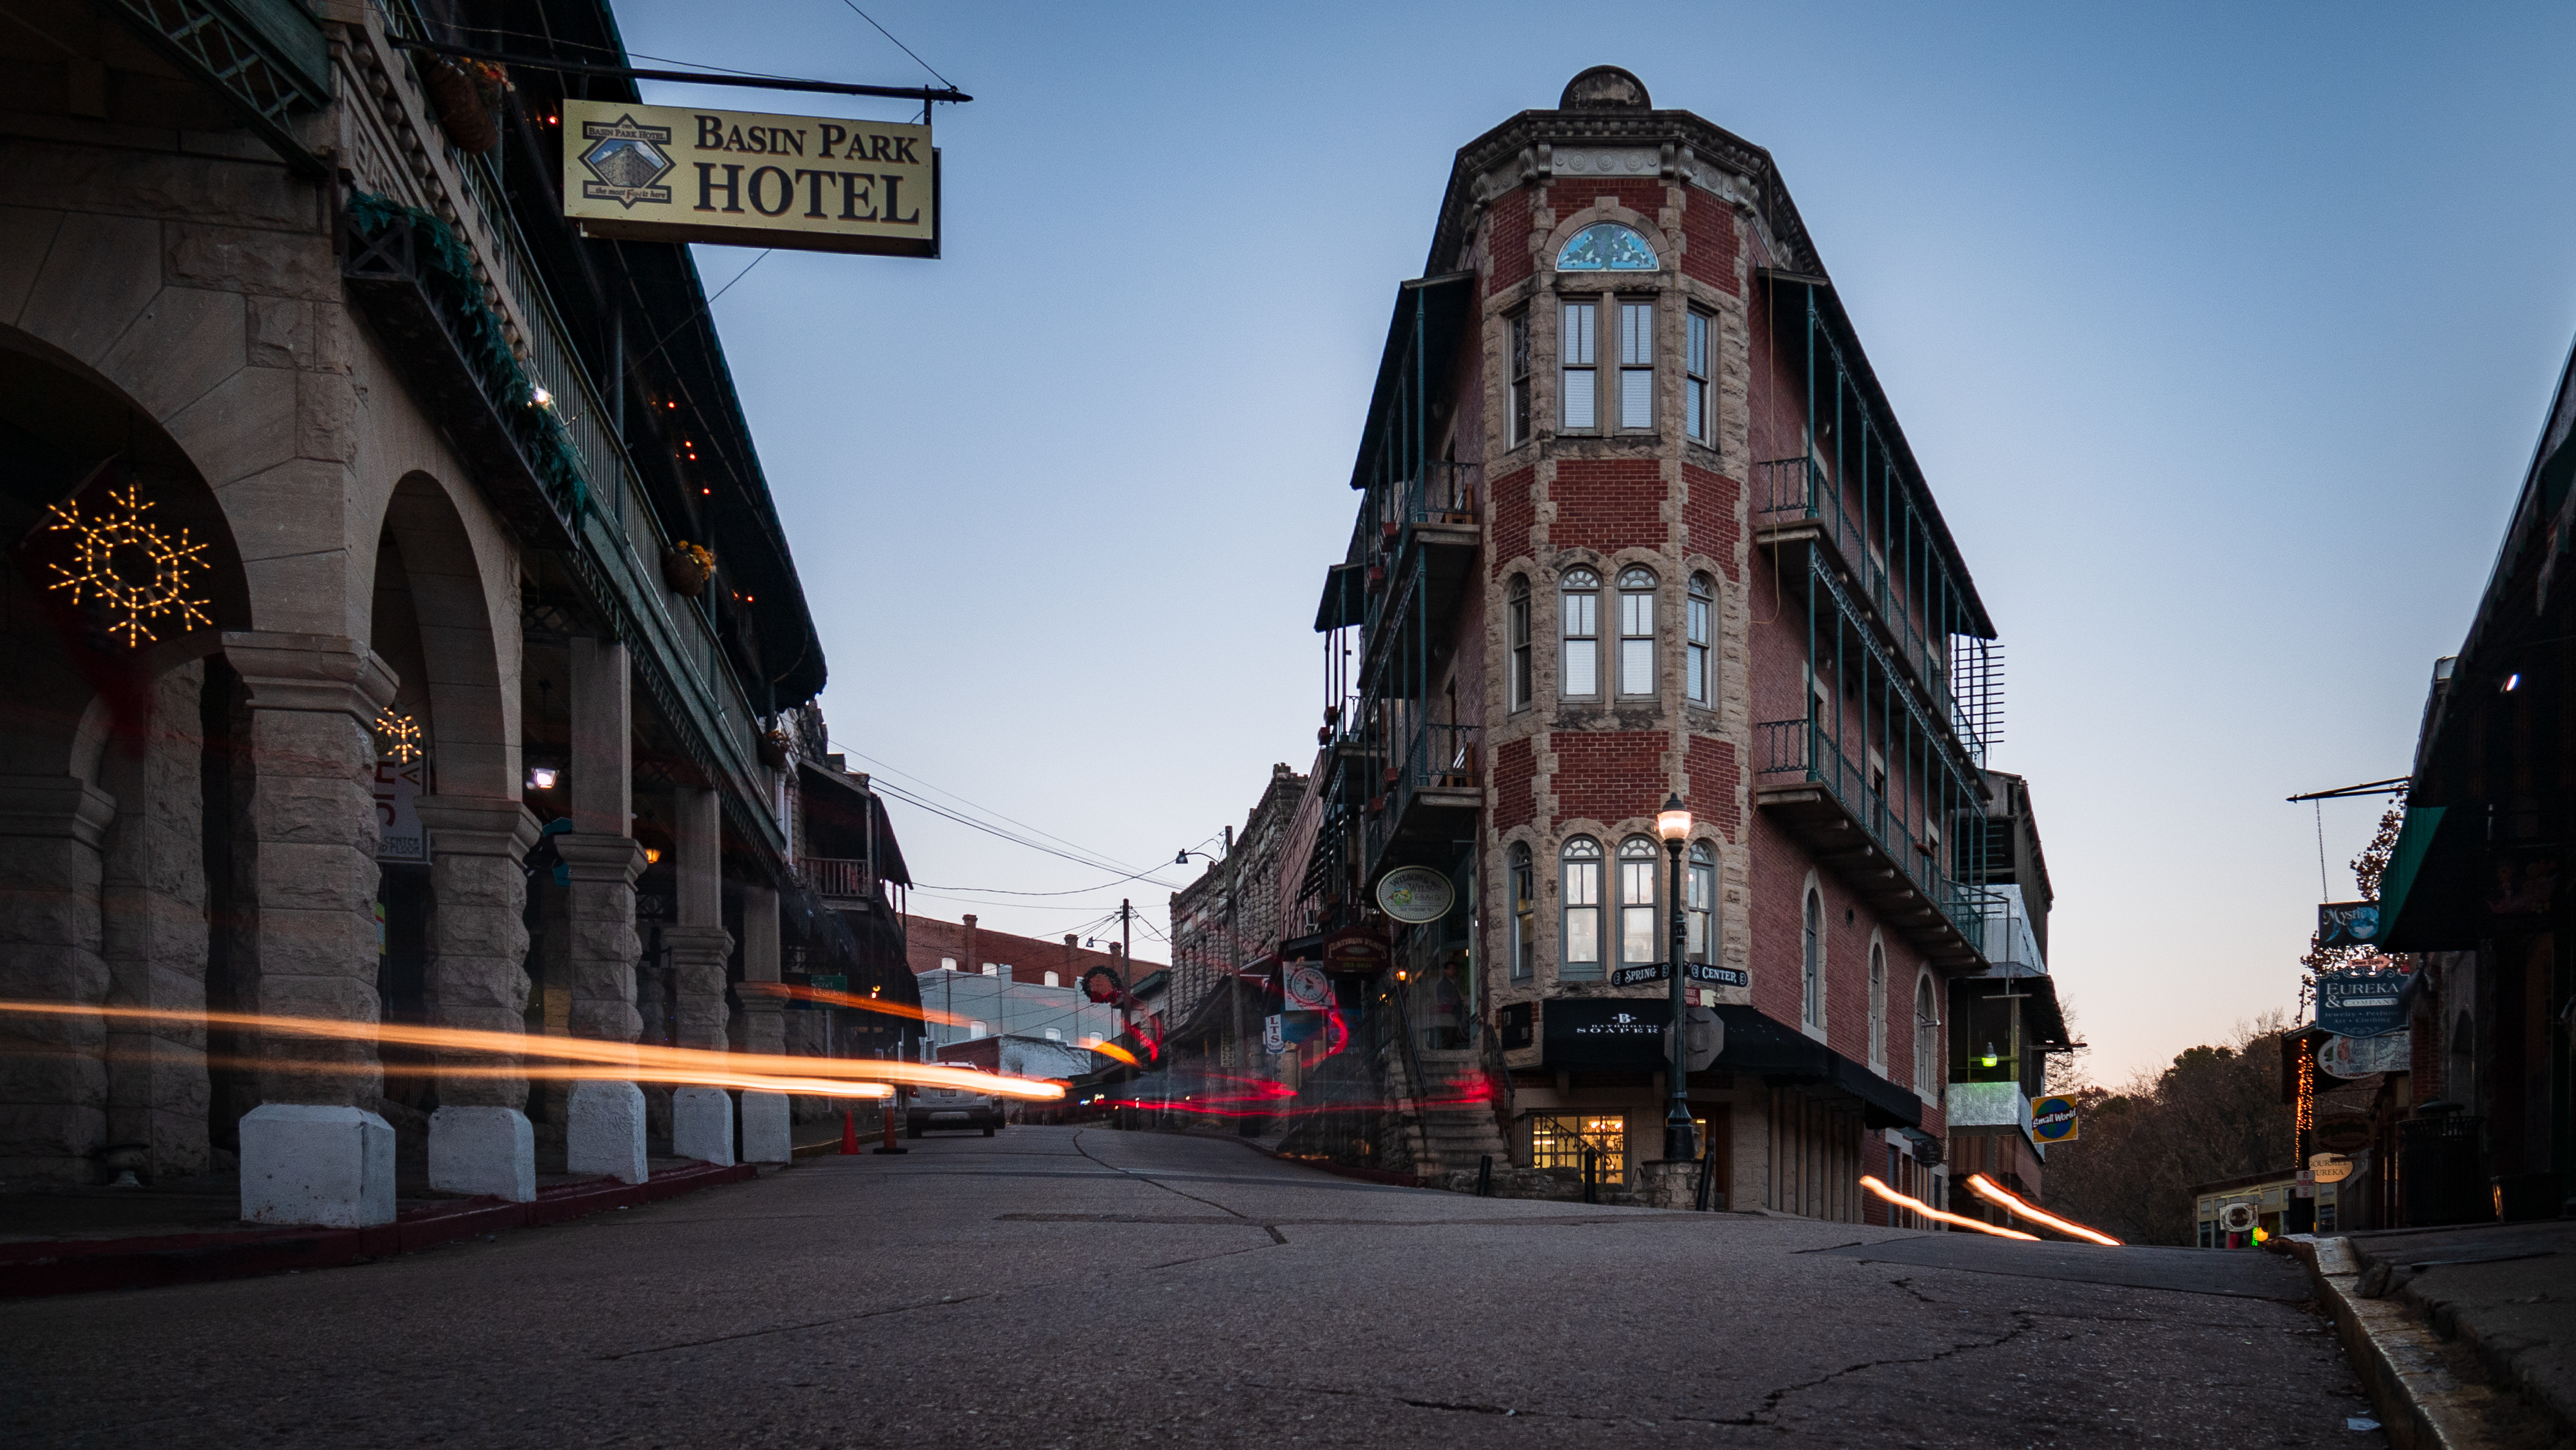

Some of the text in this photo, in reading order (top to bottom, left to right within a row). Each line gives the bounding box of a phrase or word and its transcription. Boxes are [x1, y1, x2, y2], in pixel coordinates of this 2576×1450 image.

[693, 161, 920, 224] HOTEL
[1703, 967, 1737, 983] CENTER
[2326, 983, 2399, 995] EUREKA
[2325, 995, 2342, 1008] &
[2033, 1107, 2076, 1128] Small World
